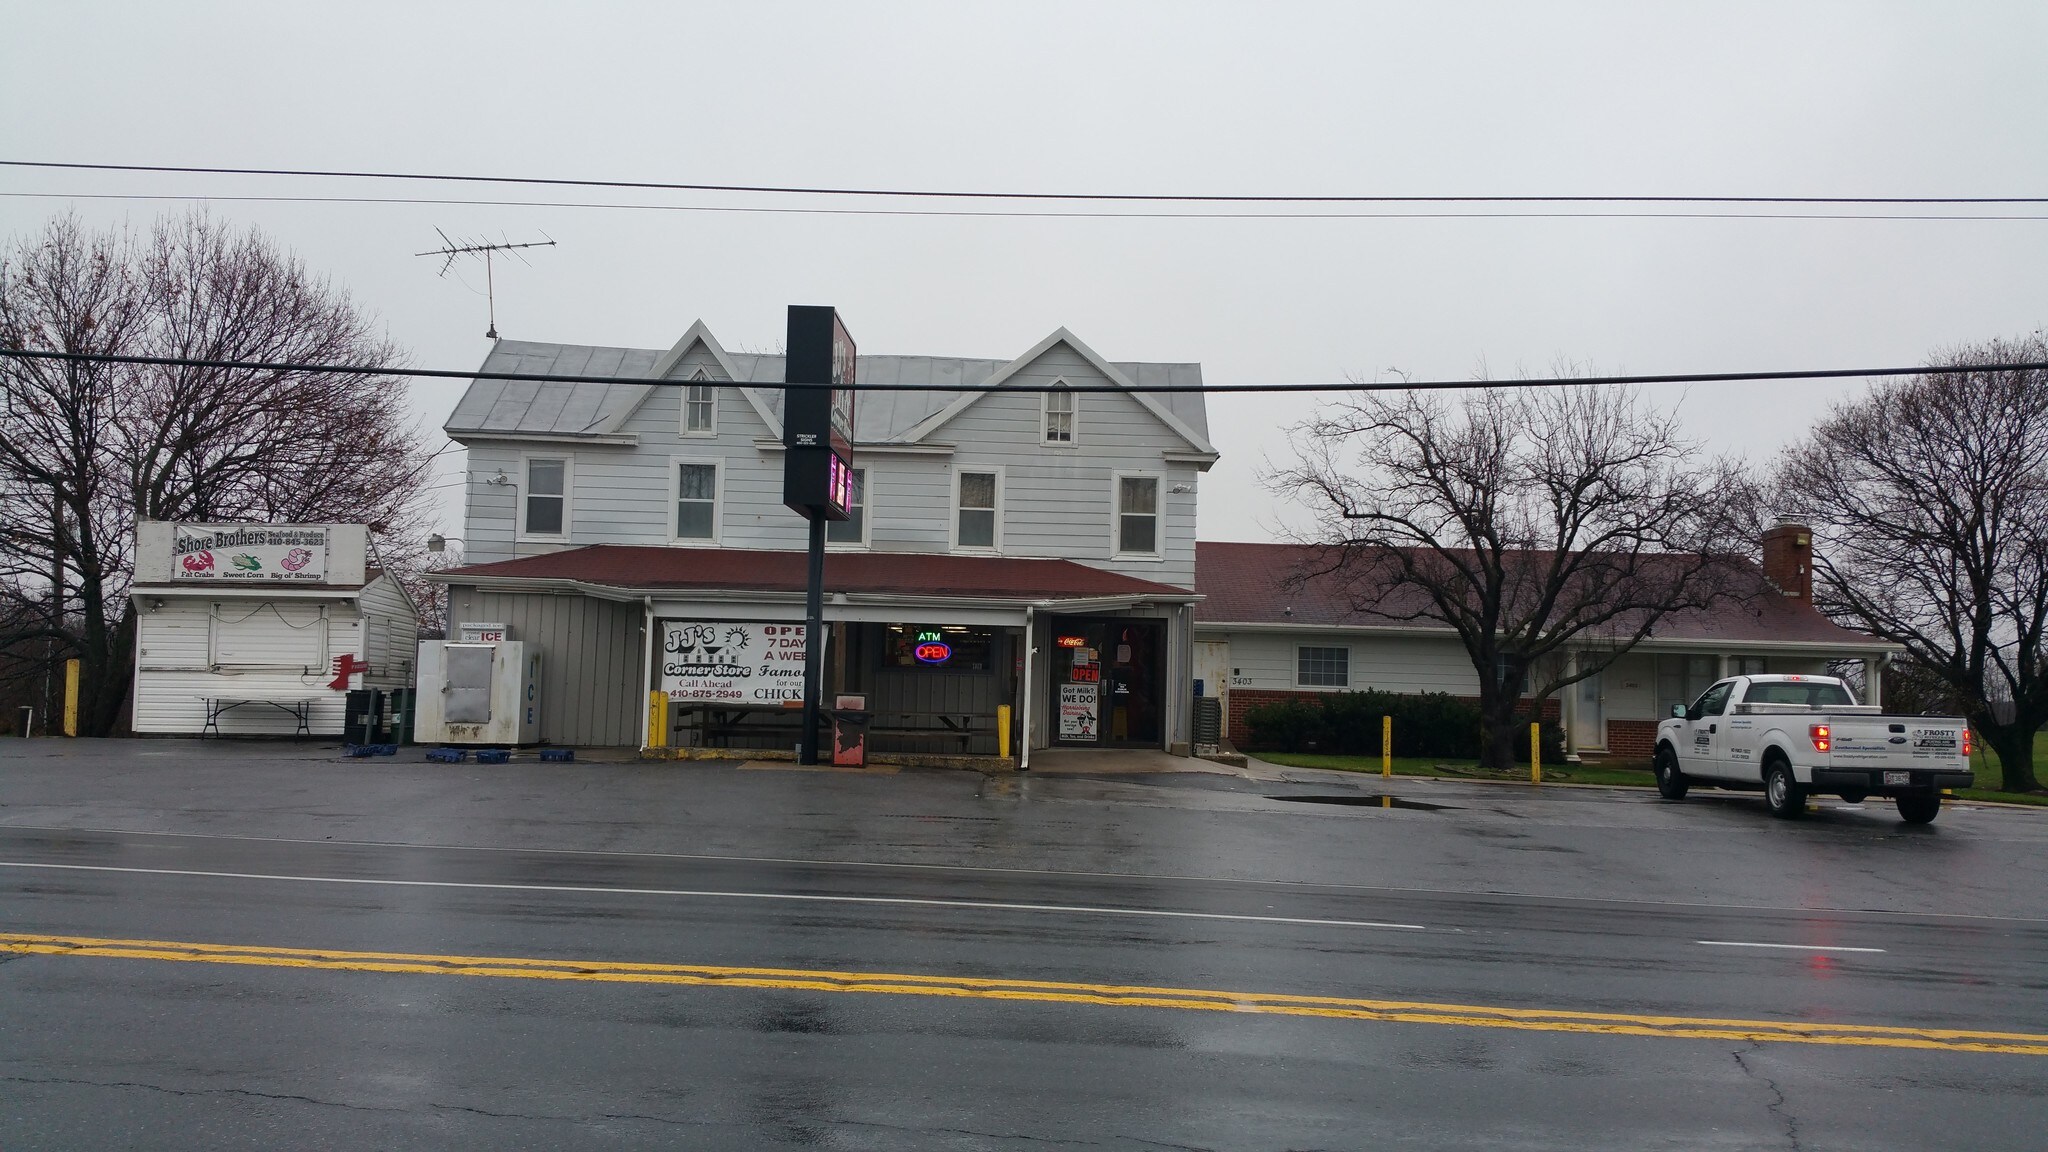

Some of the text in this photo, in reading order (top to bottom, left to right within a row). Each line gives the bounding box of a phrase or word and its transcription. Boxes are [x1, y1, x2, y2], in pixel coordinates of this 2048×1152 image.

[177, 528, 266, 555] Shore Brothers
[271, 572, 283, 580] Big
[294, 572, 321, 580] Shrimp
[764, 626, 805, 636] OPE
[481, 632, 502, 641] ICE
[665, 624, 716, 654] JJ's
[918, 632, 941, 641] ATM
[767, 639, 807, 648] 7 DAY
[764, 651, 807, 660] A WEE
[918, 646, 948, 658] OPEN
[664, 662, 752, 678] Corner Store
[758, 664, 806, 677] Famo
[1072, 668, 1099, 682] OPEN
[679, 679, 732, 688] Call Ahead
[776, 679, 788, 687] for
[1232, 678, 1253, 686] 3403
[670, 689, 743, 698] 410-875-2949
[754, 688, 803, 700] CHICK
[1062, 694, 1096, 704] WE DO!
[1923, 729, 1956, 737] FROSTY
